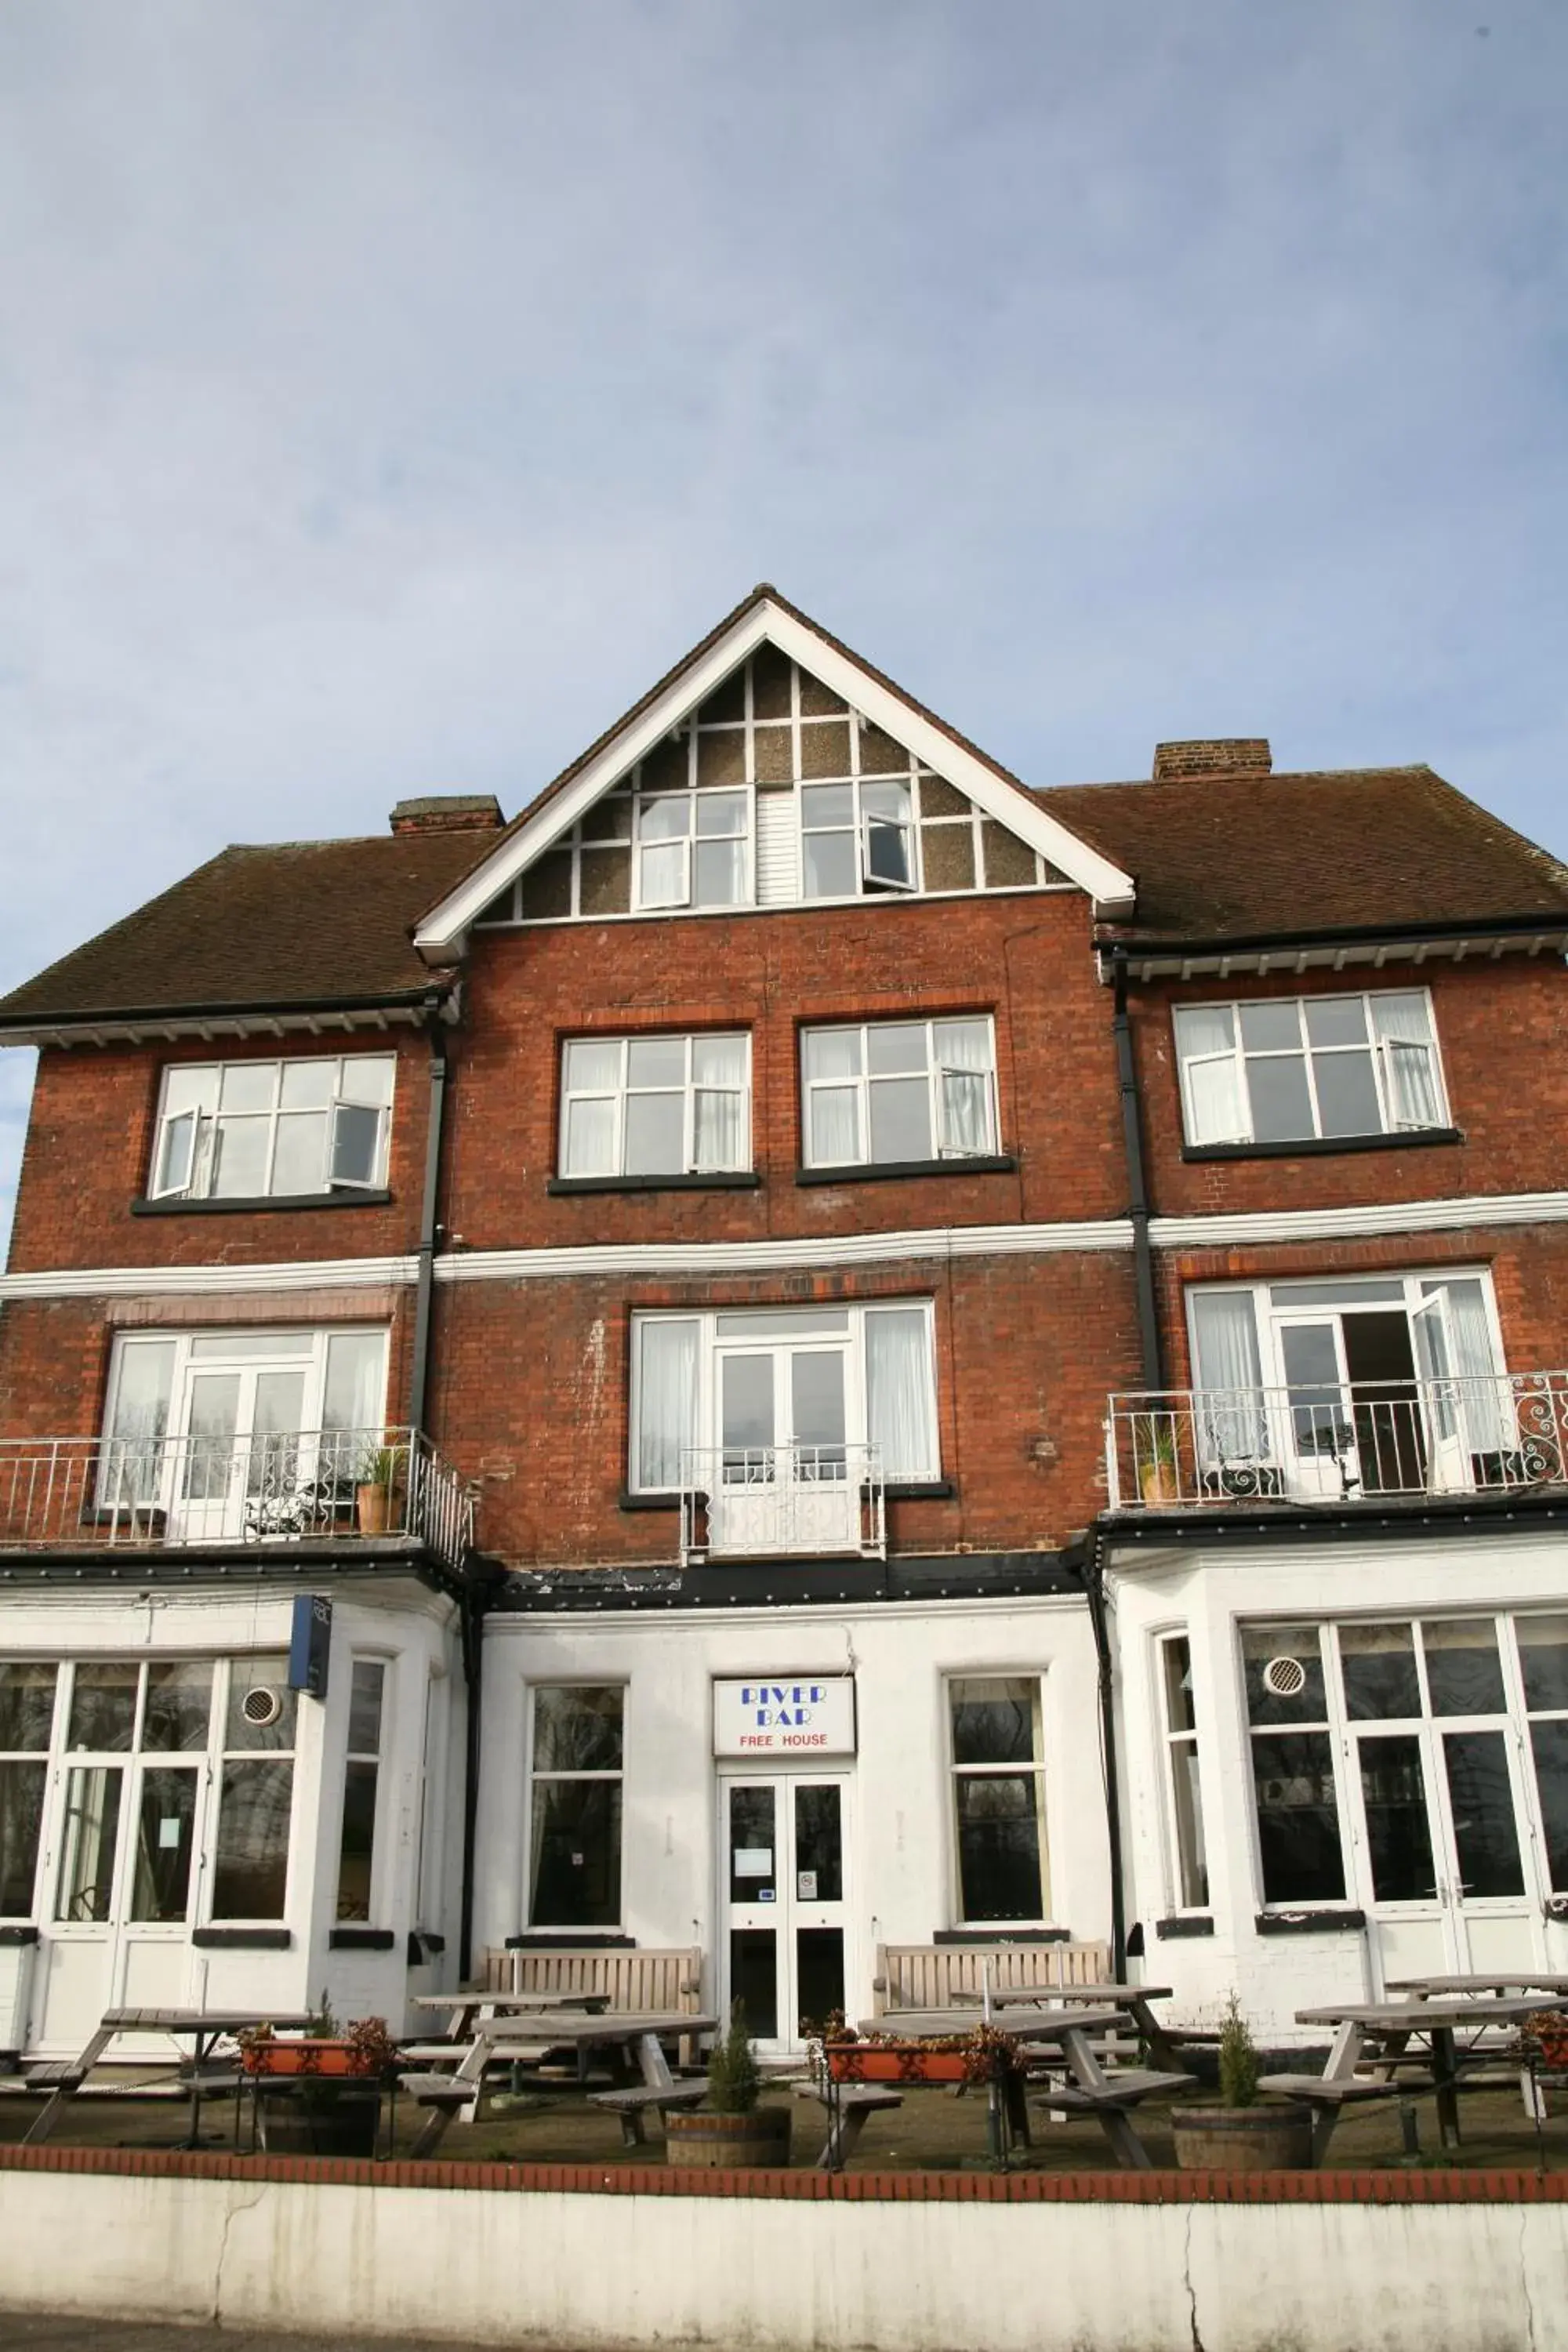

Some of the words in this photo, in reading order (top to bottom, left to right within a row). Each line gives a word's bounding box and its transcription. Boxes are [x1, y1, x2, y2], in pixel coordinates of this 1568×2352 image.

[742, 1686, 827, 1704] RIVER
[757, 1708, 812, 1726] BAR
[739, 1735, 774, 1747] FREE
[782, 1733, 828, 1746] HOUSE
